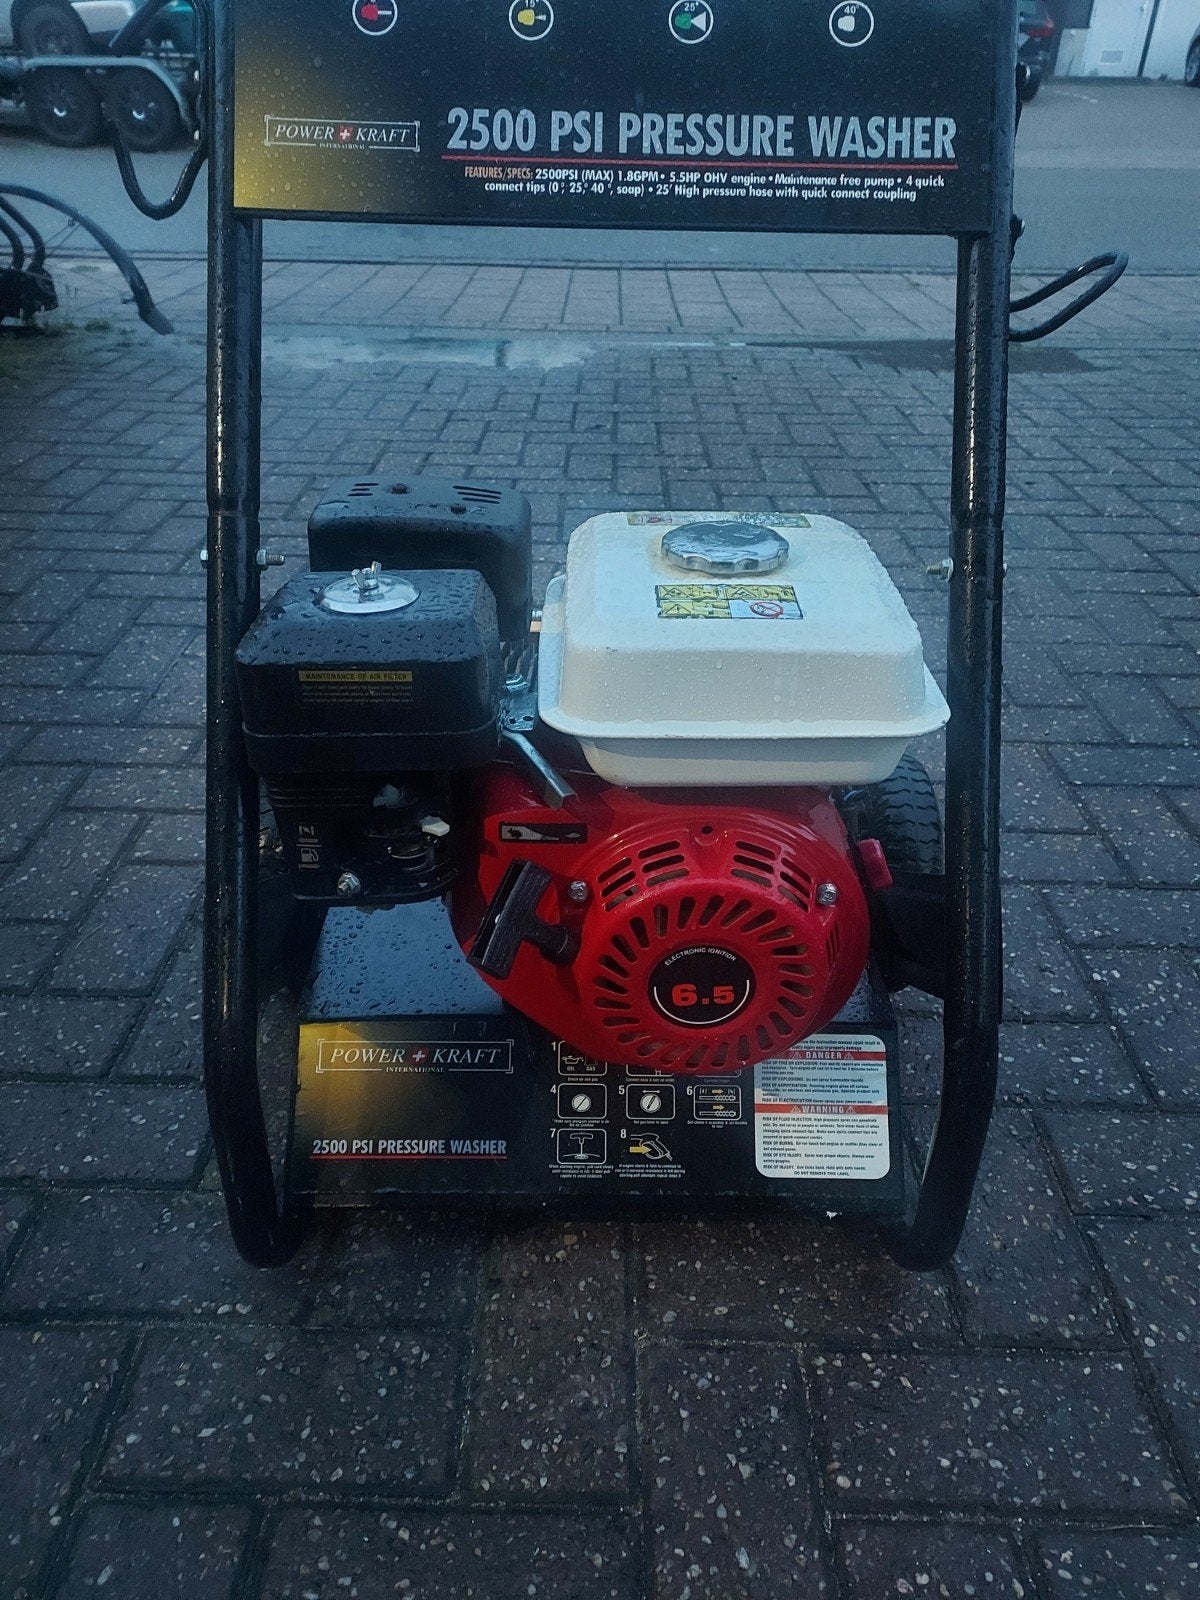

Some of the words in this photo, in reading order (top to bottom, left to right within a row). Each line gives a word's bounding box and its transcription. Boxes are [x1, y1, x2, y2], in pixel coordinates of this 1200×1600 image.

[274, 124, 335, 140] POWER
[355, 128, 410, 143] KRAFT
[447, 107, 536, 152] 2500
[550, 110, 604, 153] PSI
[619, 112, 795, 157] PRESSURE
[807, 115, 958, 159] WASHER
[319, 142, 366, 150] INTERNATIONAL
[464, 166, 533, 181] FEATURES/SPECS:
[535, 168, 578, 181] 2500PSI
[581, 169, 614, 183] (MAX)
[669, 171, 701, 183] 5.5HP
[704, 172, 728, 184] OHV
[731, 173, 766, 186] engine
[775, 173, 837, 186] Maintenance
[839, 174, 861, 186] free
[864, 177, 895, 189] pump
[905, 175, 914, 187] 4
[915, 175, 945, 189] quick
[484, 182, 523, 192] connect
[526, 181, 546, 194] tips
[616, 184, 645, 197] soap)
[674, 184, 700, 198] High
[702, 186, 746, 198] pressure
[749, 185, 773, 197] hose
[775, 186, 799, 198] with
[801, 186, 827, 200] quick
[831, 188, 870, 199] connect
[873, 187, 917, 202] coupling
[664, 947, 707, 966] ELECTRONIC
[707, 947, 737, 962] IGNITION
[671, 983, 735, 1007] 6.5
[330, 1048, 405, 1064] POWER
[432, 1048, 502, 1064] KRAFT
[805, 1051, 843, 1060] DANGER
[550, 1085, 557, 1094] 4
[618, 1085, 625, 1095] 5
[686, 1086, 693, 1095] 6
[801, 1105, 845, 1114] WARNING
[550, 1129, 557, 1138] 7
[620, 1129, 627, 1138] 8
[312, 1139, 348, 1155] 2500
[352, 1139, 374, 1155] PSI
[378, 1139, 445, 1155] PRESSURE
[449, 1139, 507, 1155] WASHER
